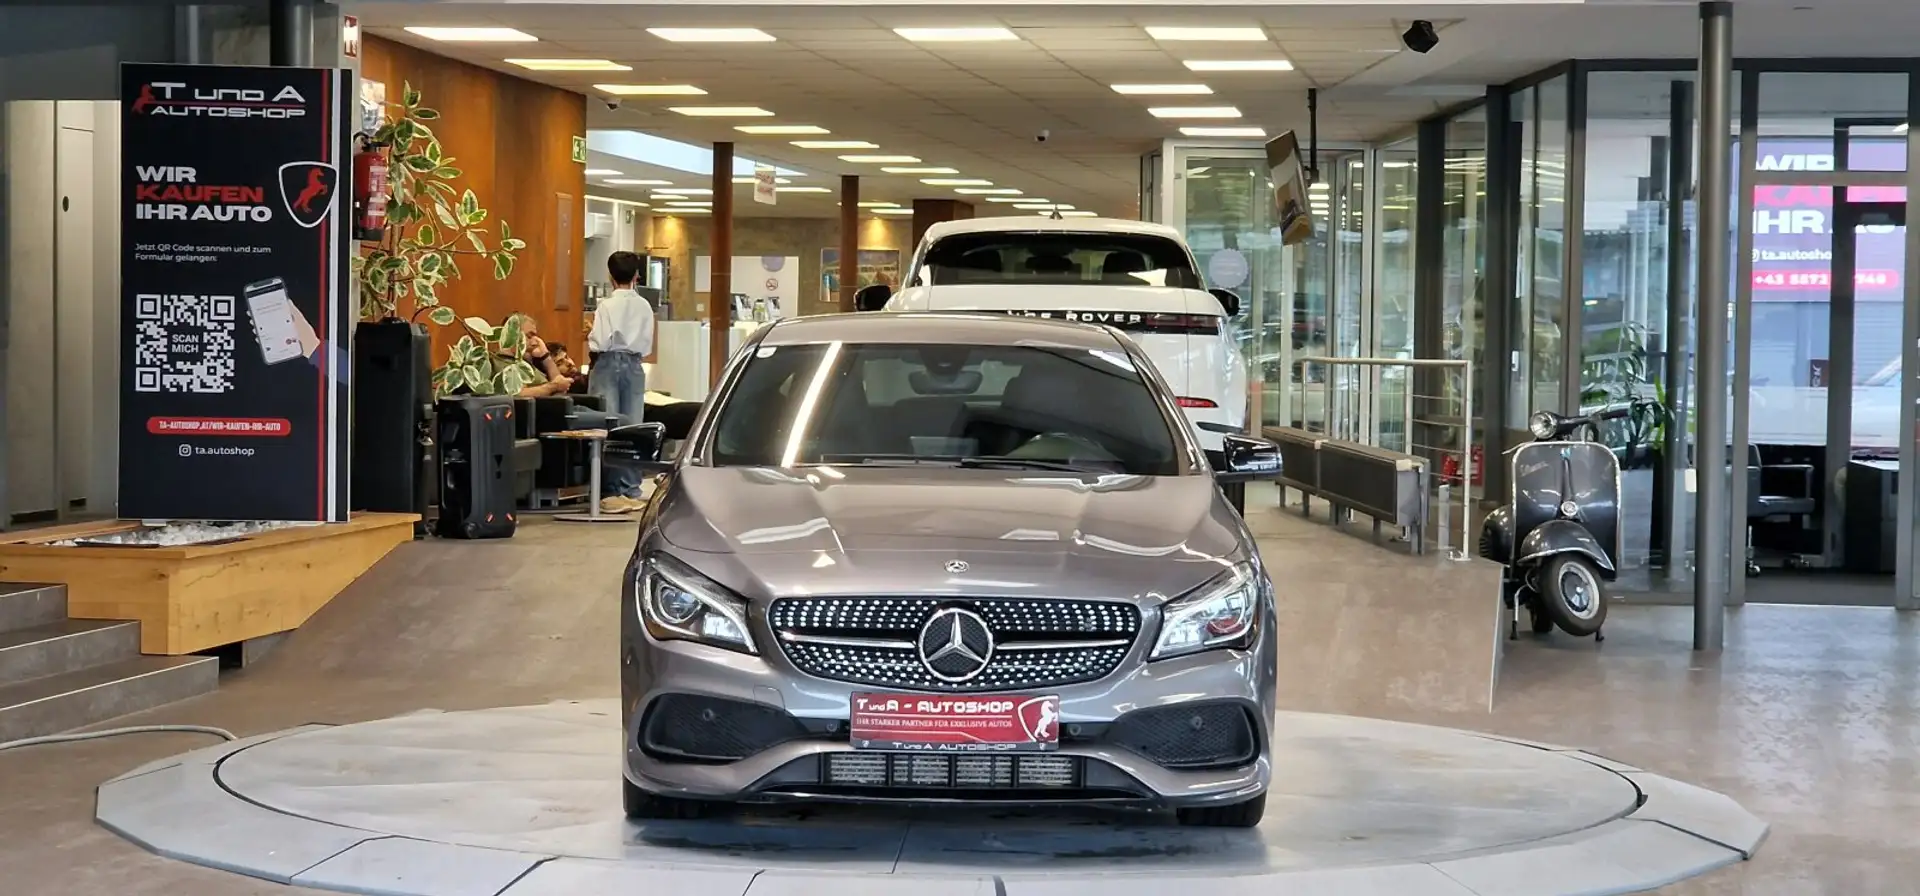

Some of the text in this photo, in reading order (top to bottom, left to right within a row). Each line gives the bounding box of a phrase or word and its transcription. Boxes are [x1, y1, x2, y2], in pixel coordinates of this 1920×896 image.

[151, 82, 186, 99] T
[272, 85, 306, 102] A
[151, 105, 306, 118] AUTOSHOP
[136, 165, 197, 183] WIR
[136, 184, 264, 203] KAUFEN
[136, 204, 273, 222] IHR AUTO
[135, 243, 156, 252] Jetzt
[157, 243, 171, 252] QR
[172, 243, 195, 252] Code
[233, 245, 251, 253] und
[175, 254, 218, 263] gelangen:
[1762, 248, 1833, 261] ta.autosho
[1065, 311, 1143, 323] ROVER
[172, 334, 199, 344] SCAN
[172, 343, 199, 353] MICH
[194, 446, 255, 457] ta.autoshop
[857, 698, 868, 710] T
[886, 699, 899, 711] A
[917, 700, 1014, 713] AUTOSHOP
[901, 719, 933, 727] PARTNER
[988, 719, 1013, 727] AUTOS
[938, 743, 1017, 751] AUTOSHOP
